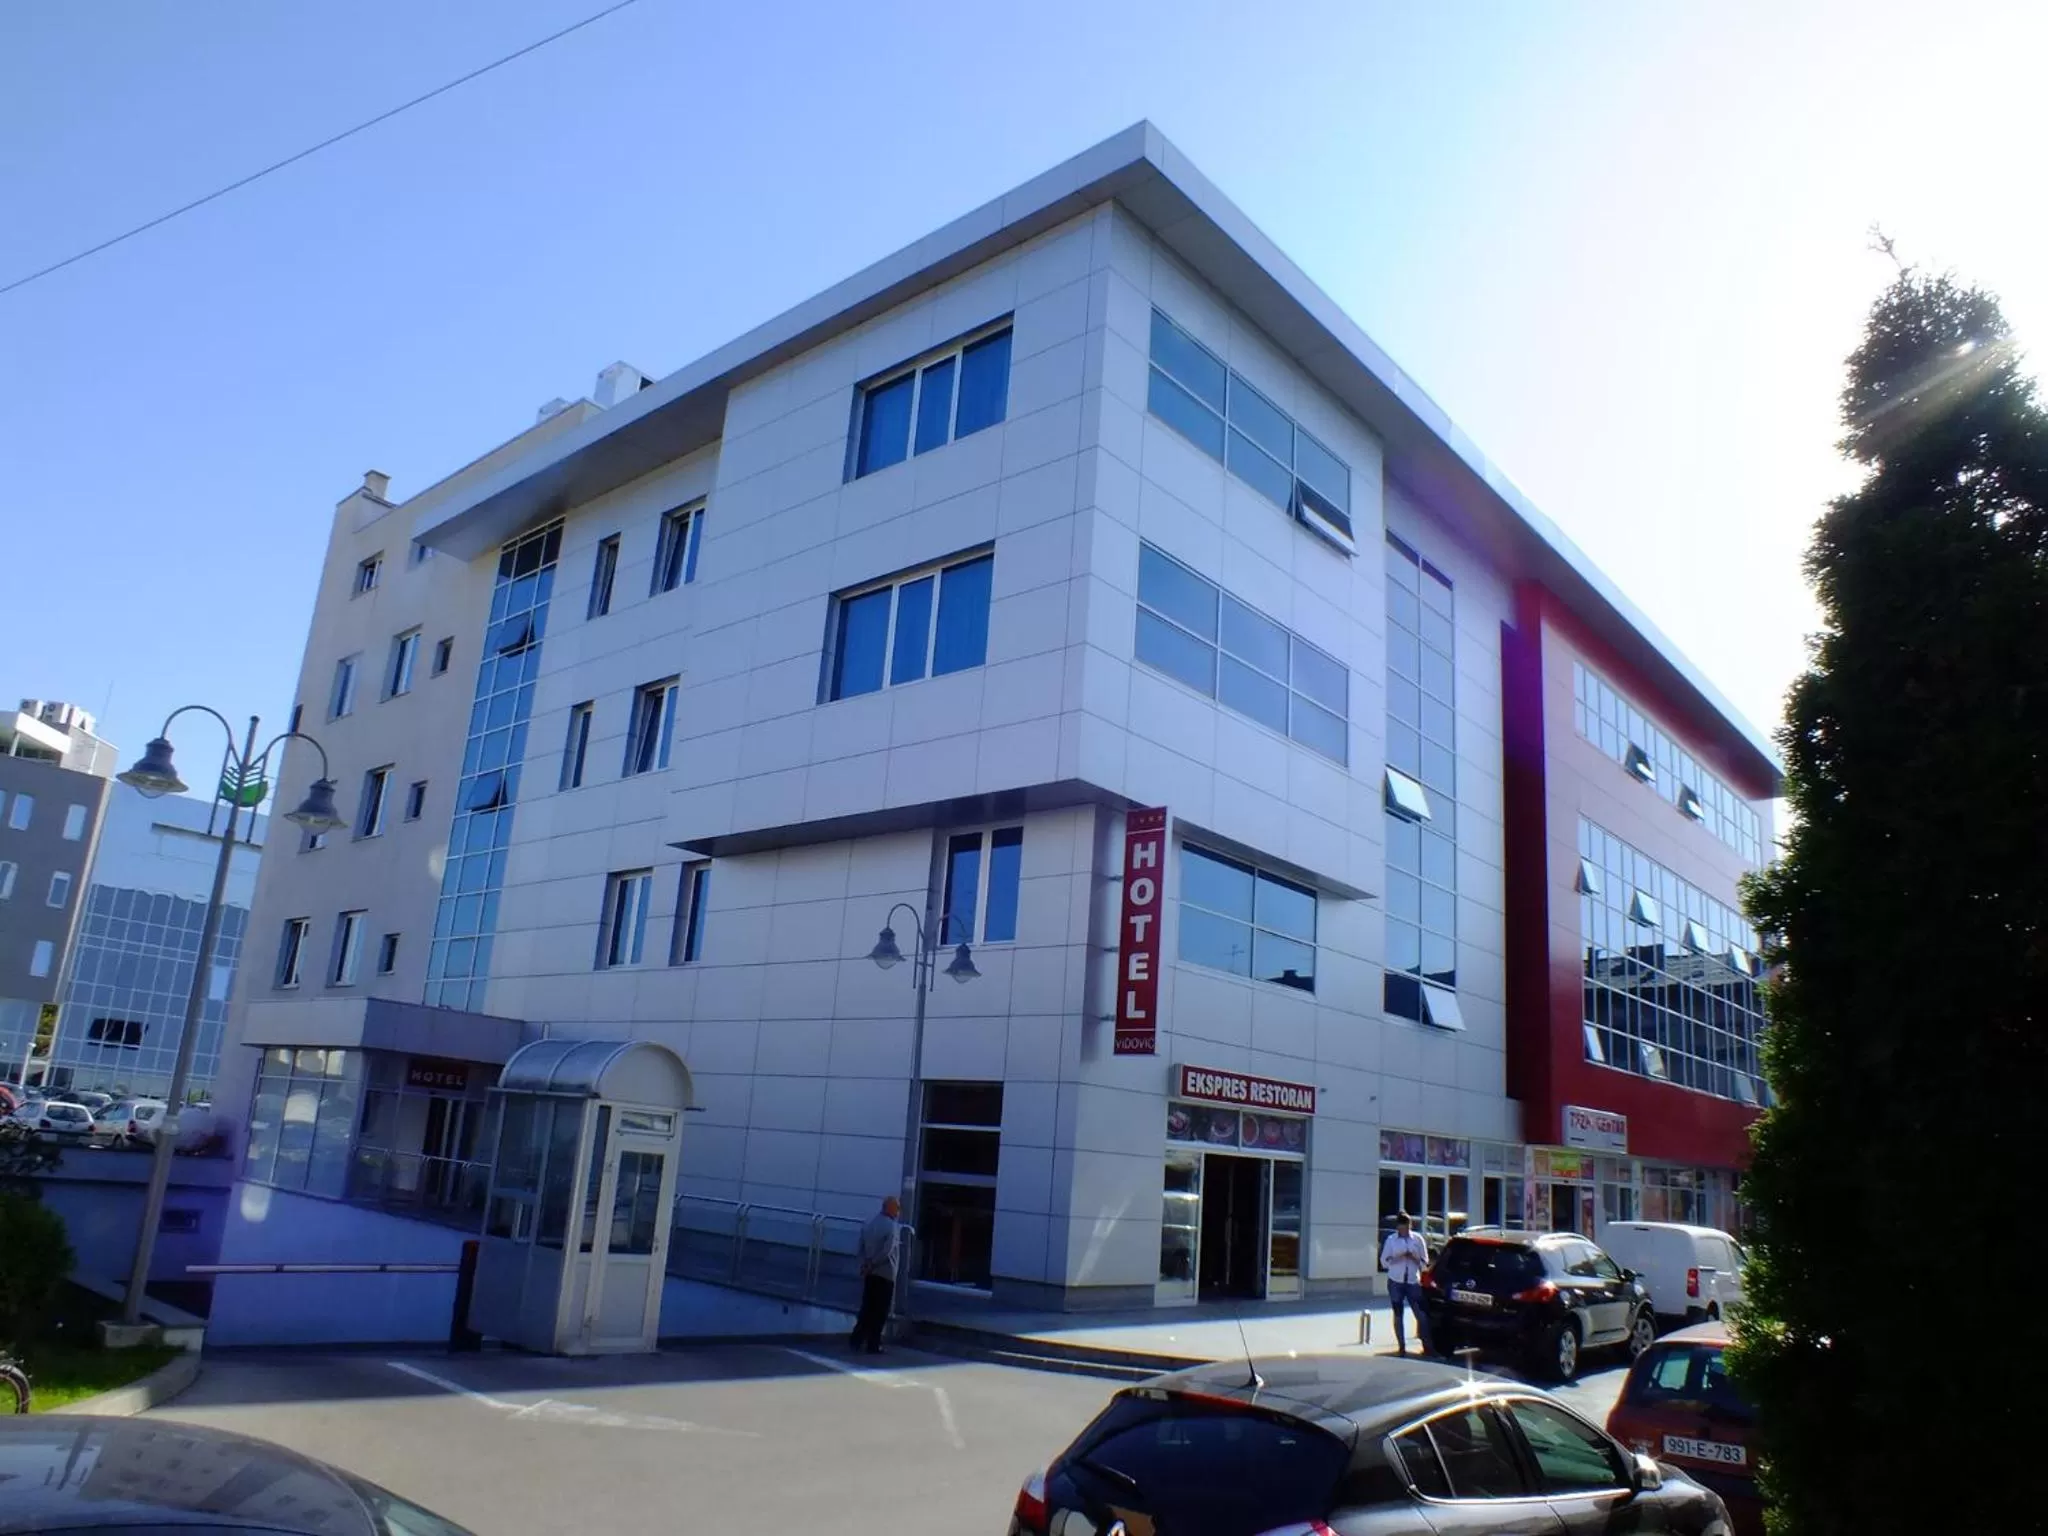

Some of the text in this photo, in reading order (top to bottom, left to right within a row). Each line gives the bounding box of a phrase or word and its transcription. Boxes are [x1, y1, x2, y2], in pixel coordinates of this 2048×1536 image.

[1126, 841, 1156, 1019] HOTEL
[411, 1069, 465, 1086] HOTEL
[1187, 1071, 1312, 1109] EKSPRES RESTORAN
[1668, 1438, 1741, 1462] 991-E-783
